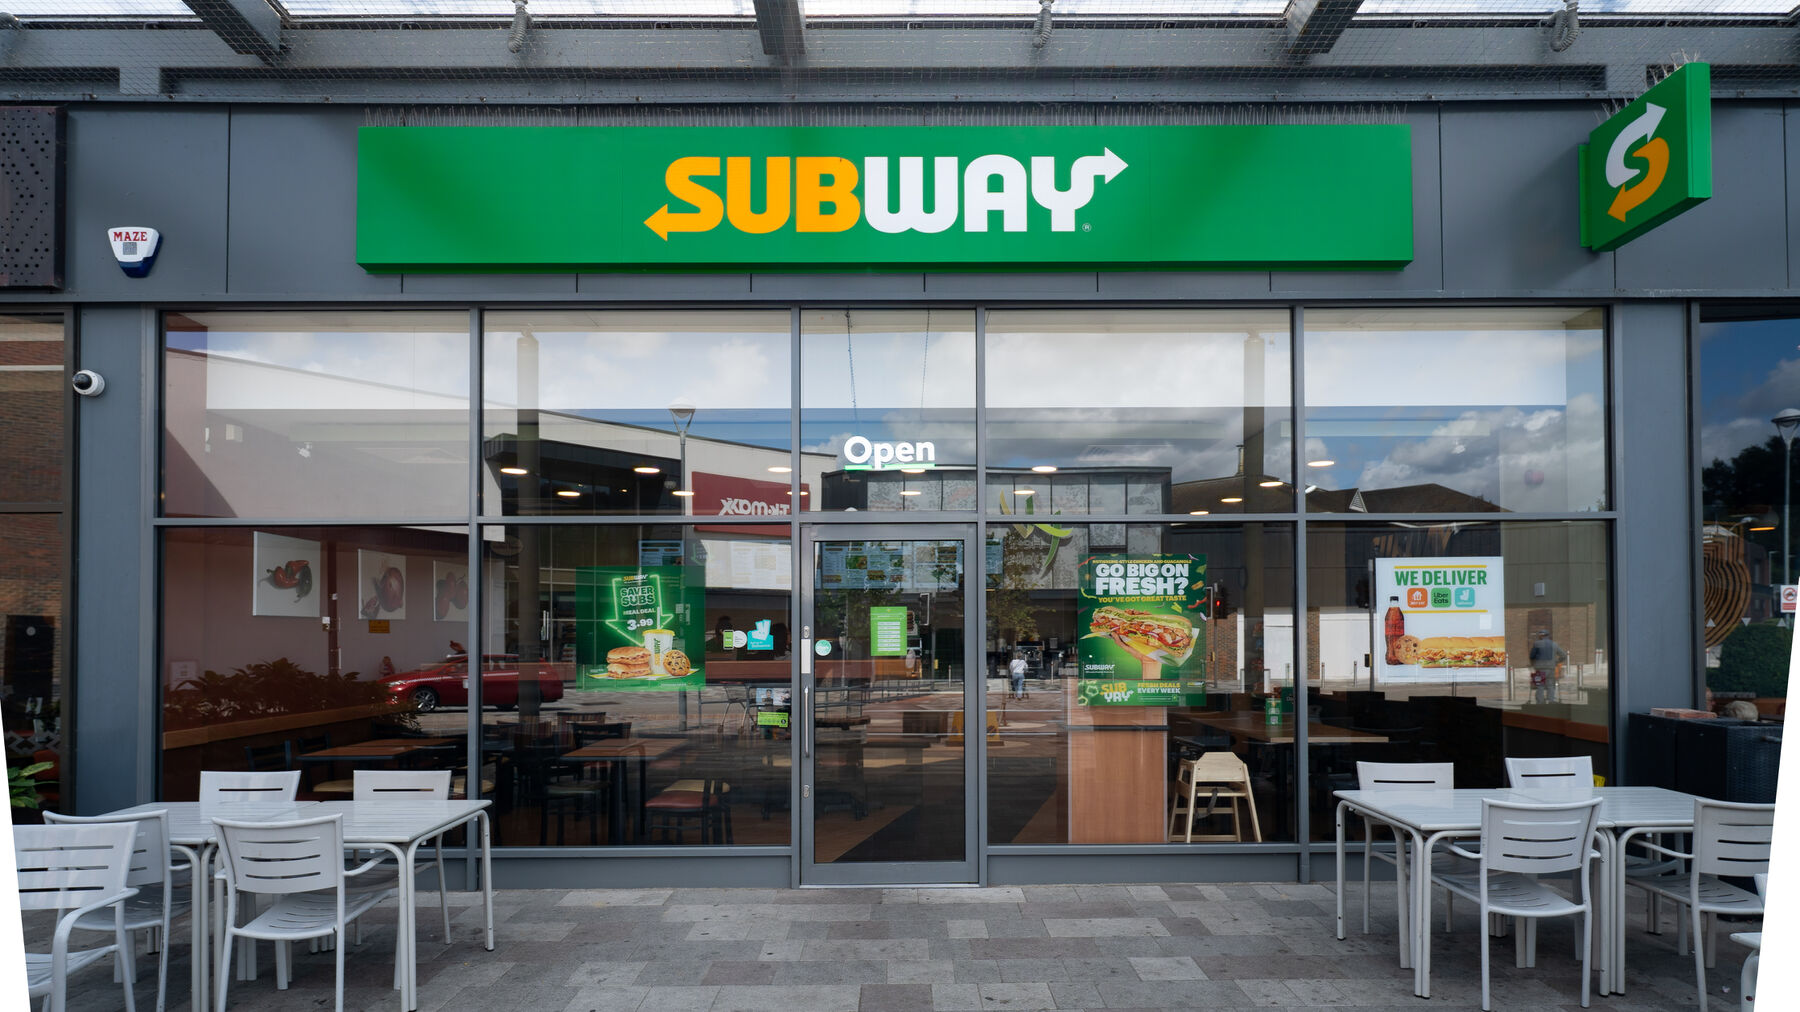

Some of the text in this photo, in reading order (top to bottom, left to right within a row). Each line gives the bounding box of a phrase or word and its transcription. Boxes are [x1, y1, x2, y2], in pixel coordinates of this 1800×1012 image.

[644, 147, 1129, 241] SUBWAY
[113, 231, 148, 242] MAZE
[844, 435, 936, 471] Open
[1095, 563, 1189, 577] GO BIG ON
[1394, 570, 1488, 586] WE DELIVER
[621, 586, 655, 597] SAVER
[1095, 577, 1189, 596] FRESH?
[621, 595, 656, 607] SUBS
[627, 618, 654, 631] 3.99
[1100, 682, 1127, 695] SUB
[1104, 689, 1134, 702] YAY
